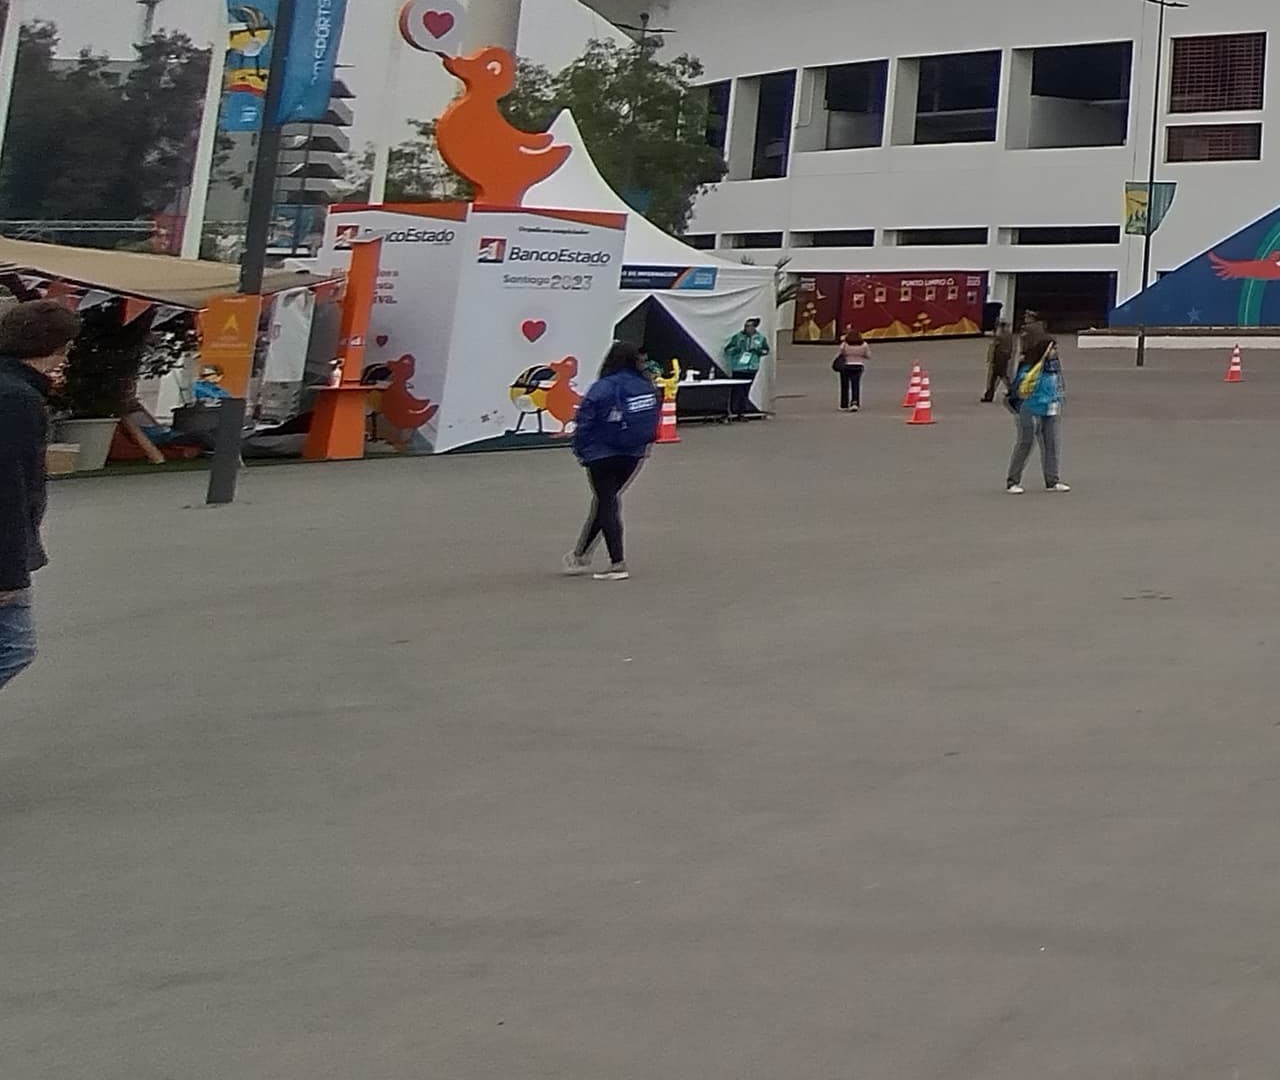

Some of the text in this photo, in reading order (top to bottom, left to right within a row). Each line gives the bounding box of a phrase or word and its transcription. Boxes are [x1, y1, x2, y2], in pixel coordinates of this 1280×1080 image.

[508, 247, 611, 263] BancoEstado
[503, 274, 593, 290] Santiago 2023
